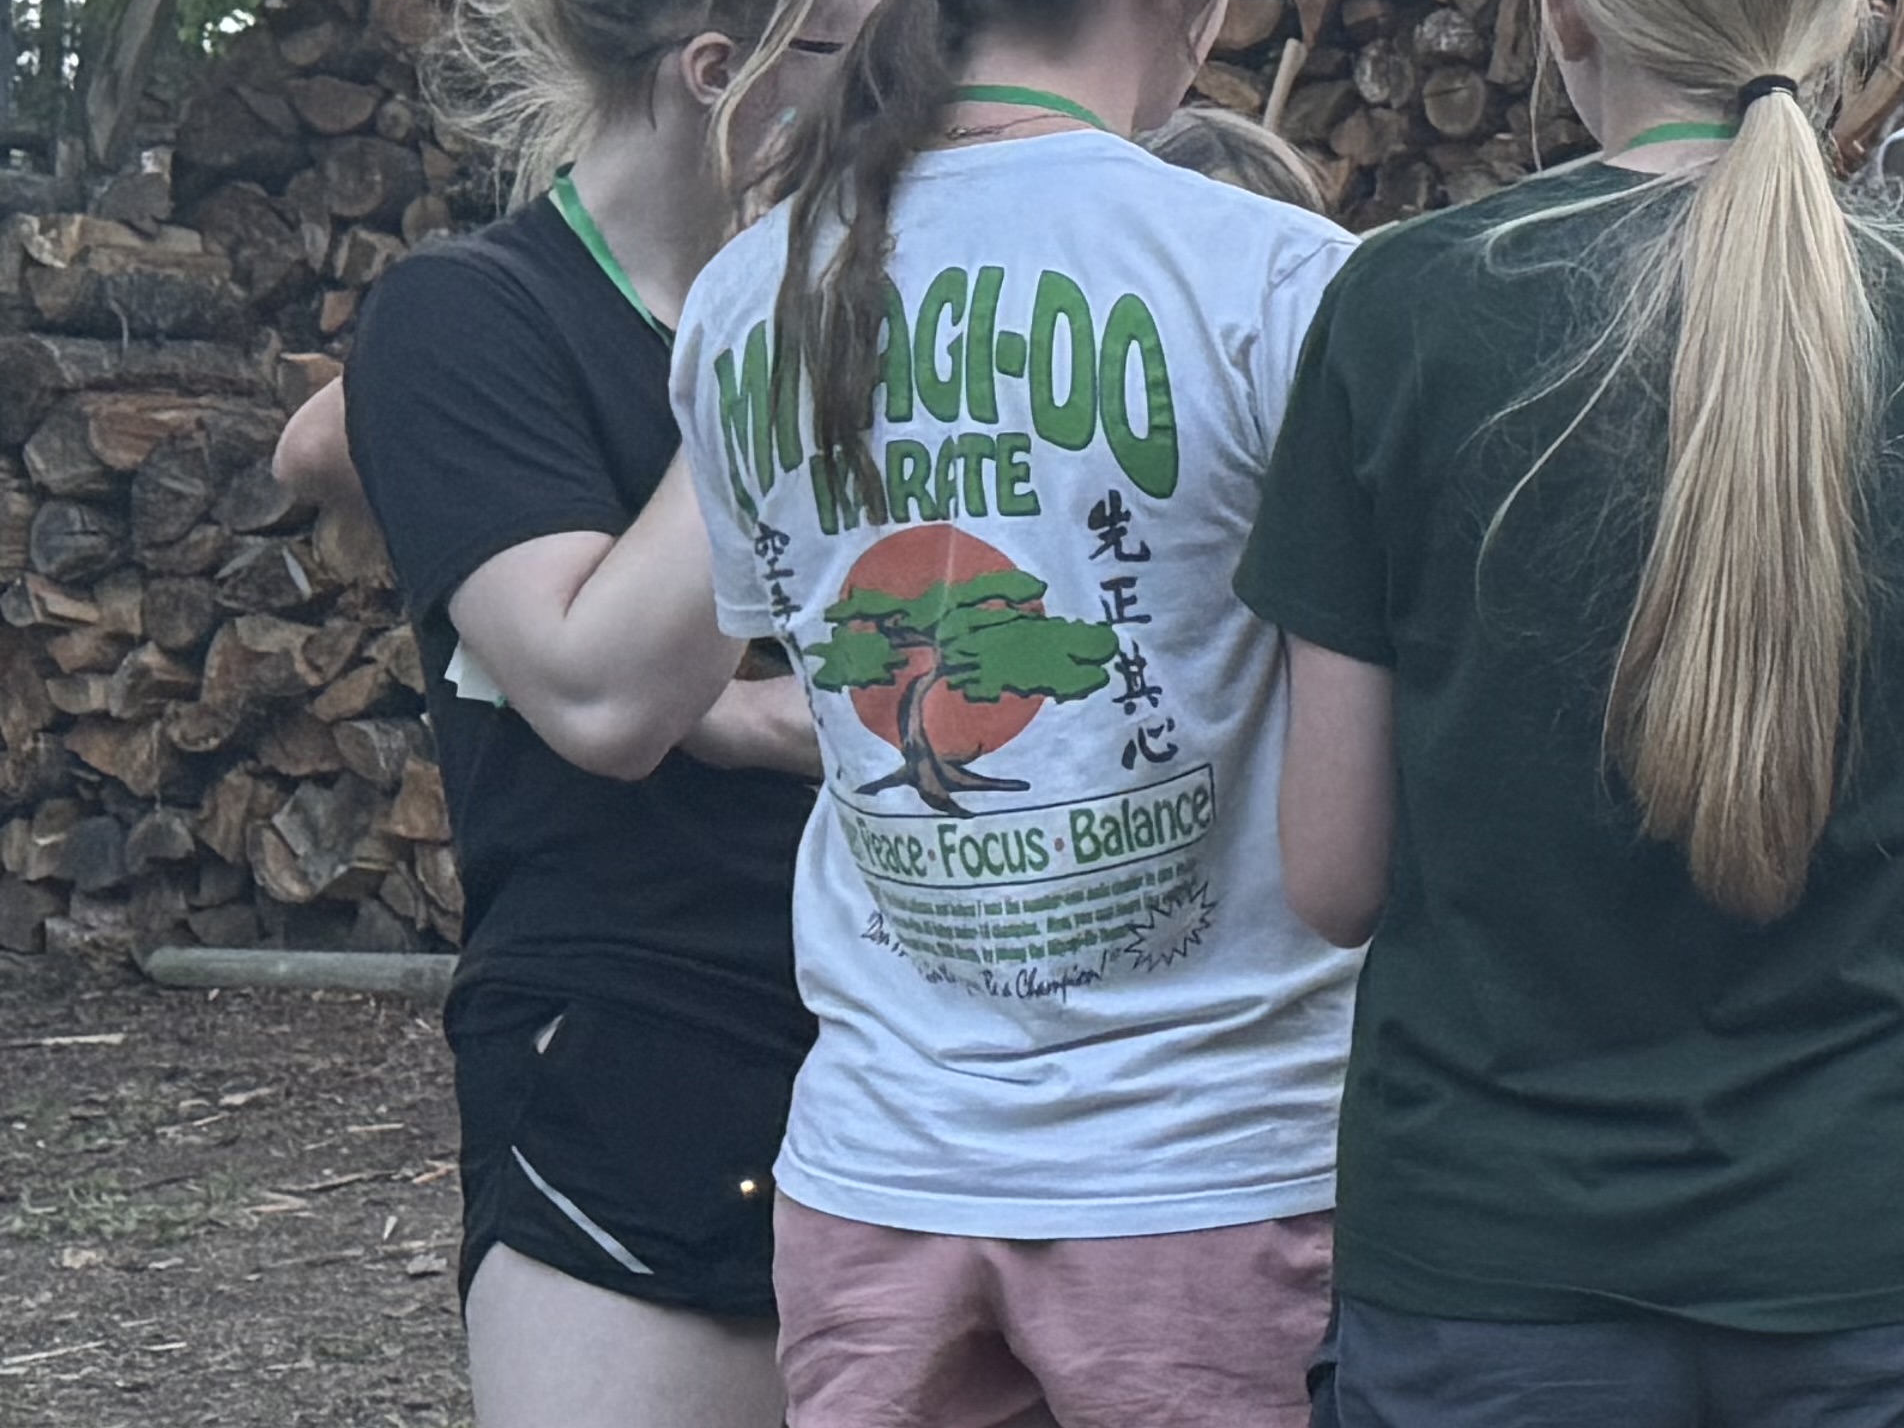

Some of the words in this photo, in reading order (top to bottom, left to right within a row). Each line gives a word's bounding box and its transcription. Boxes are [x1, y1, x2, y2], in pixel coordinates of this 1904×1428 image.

[713, 265, 1180, 520] MIAGI-DO
[856, 816, 928, 878] Peace
[937, 823, 1050, 878] Focus
[1069, 784, 1213, 865] Balance
